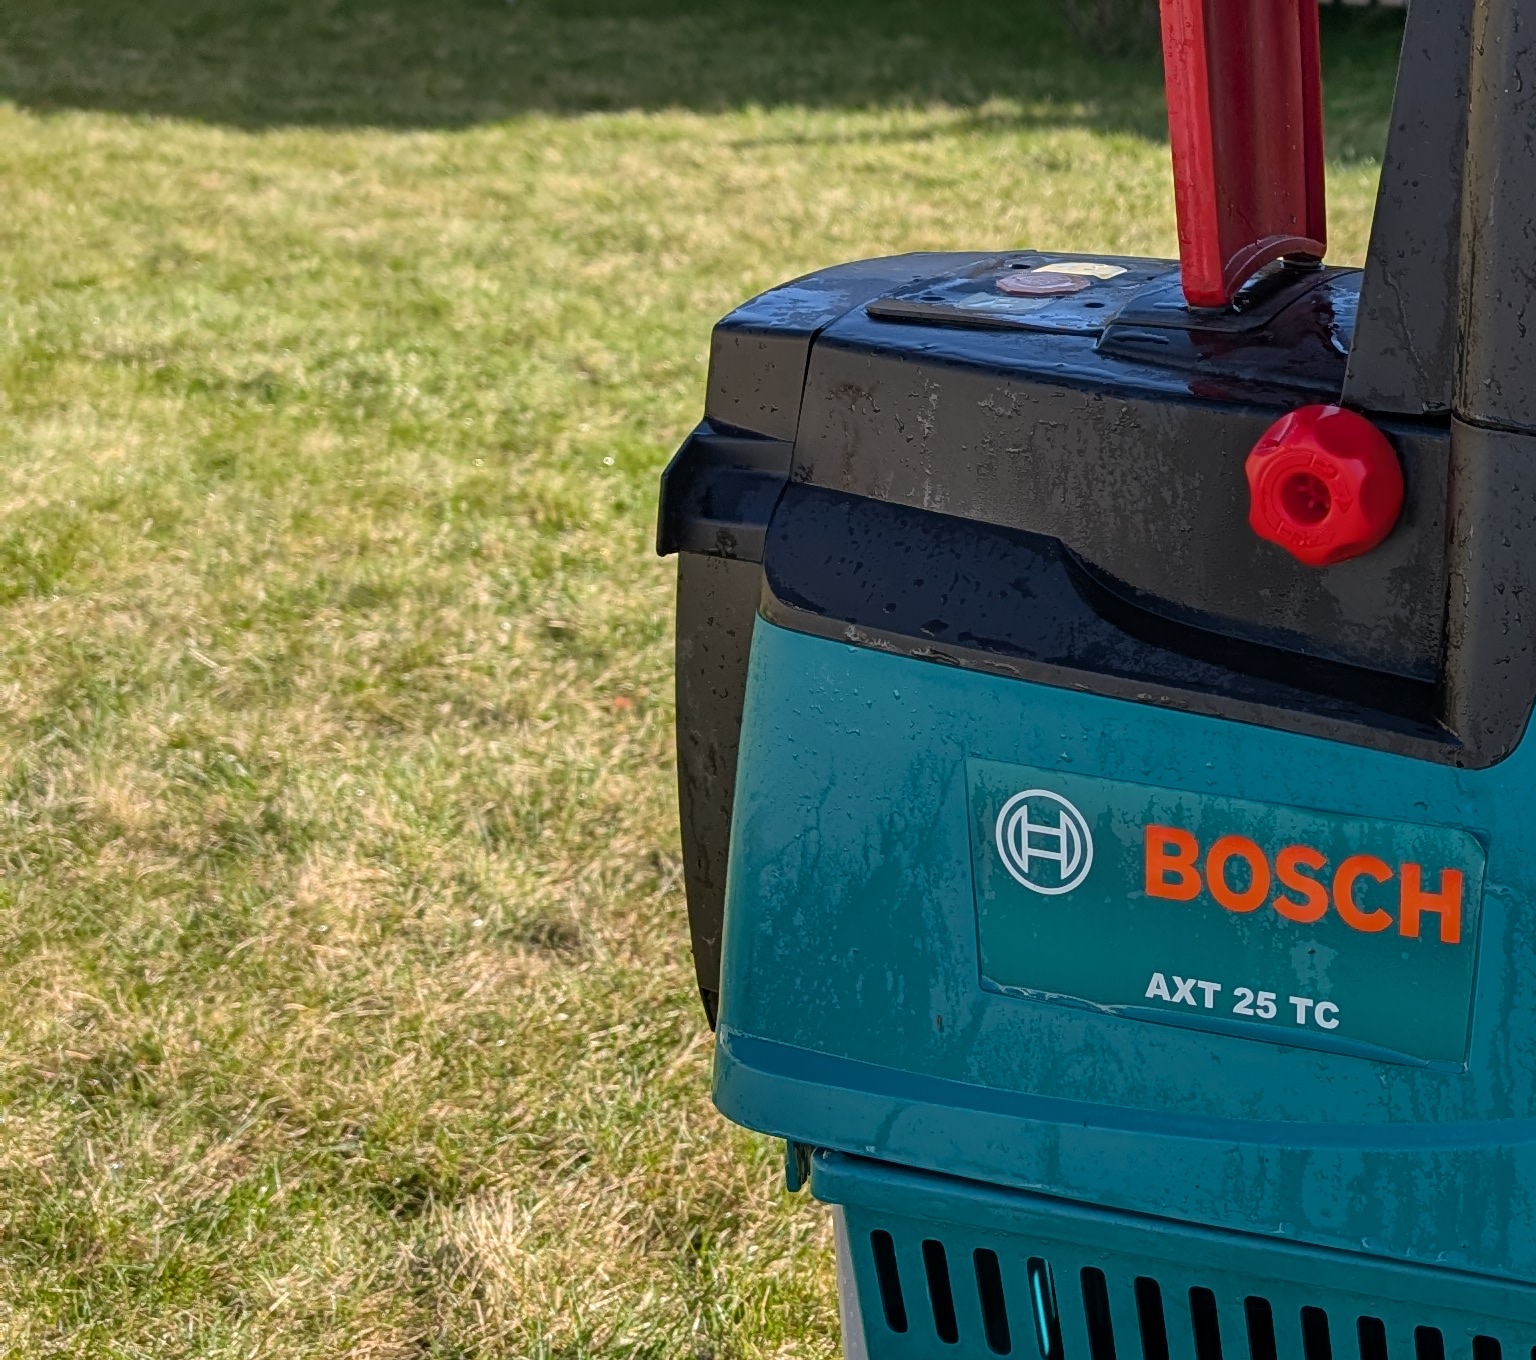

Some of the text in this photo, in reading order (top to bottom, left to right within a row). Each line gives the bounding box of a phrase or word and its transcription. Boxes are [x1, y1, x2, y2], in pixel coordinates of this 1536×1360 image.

[1145, 824, 1463, 944] BOSCH
[1144, 972, 1340, 1030] AXT 25 TC
